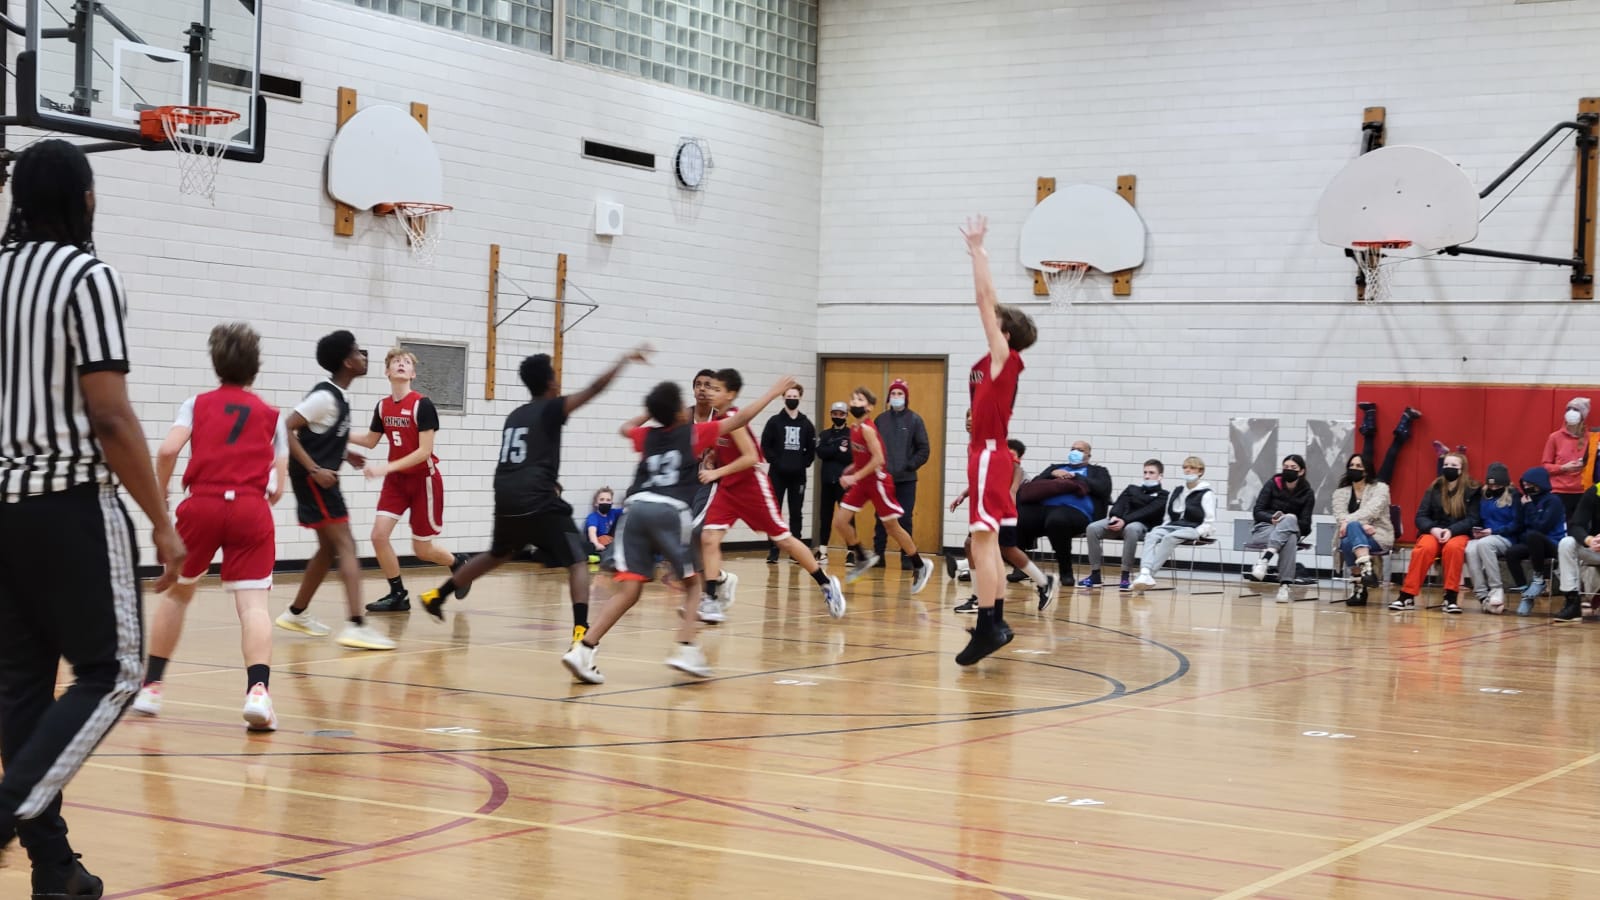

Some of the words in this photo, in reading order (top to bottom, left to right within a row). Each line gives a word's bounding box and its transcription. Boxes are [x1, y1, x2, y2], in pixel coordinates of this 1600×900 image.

[224, 403, 251, 445] 7
[392, 430, 402, 446] 5
[500, 427, 529, 464] 15
